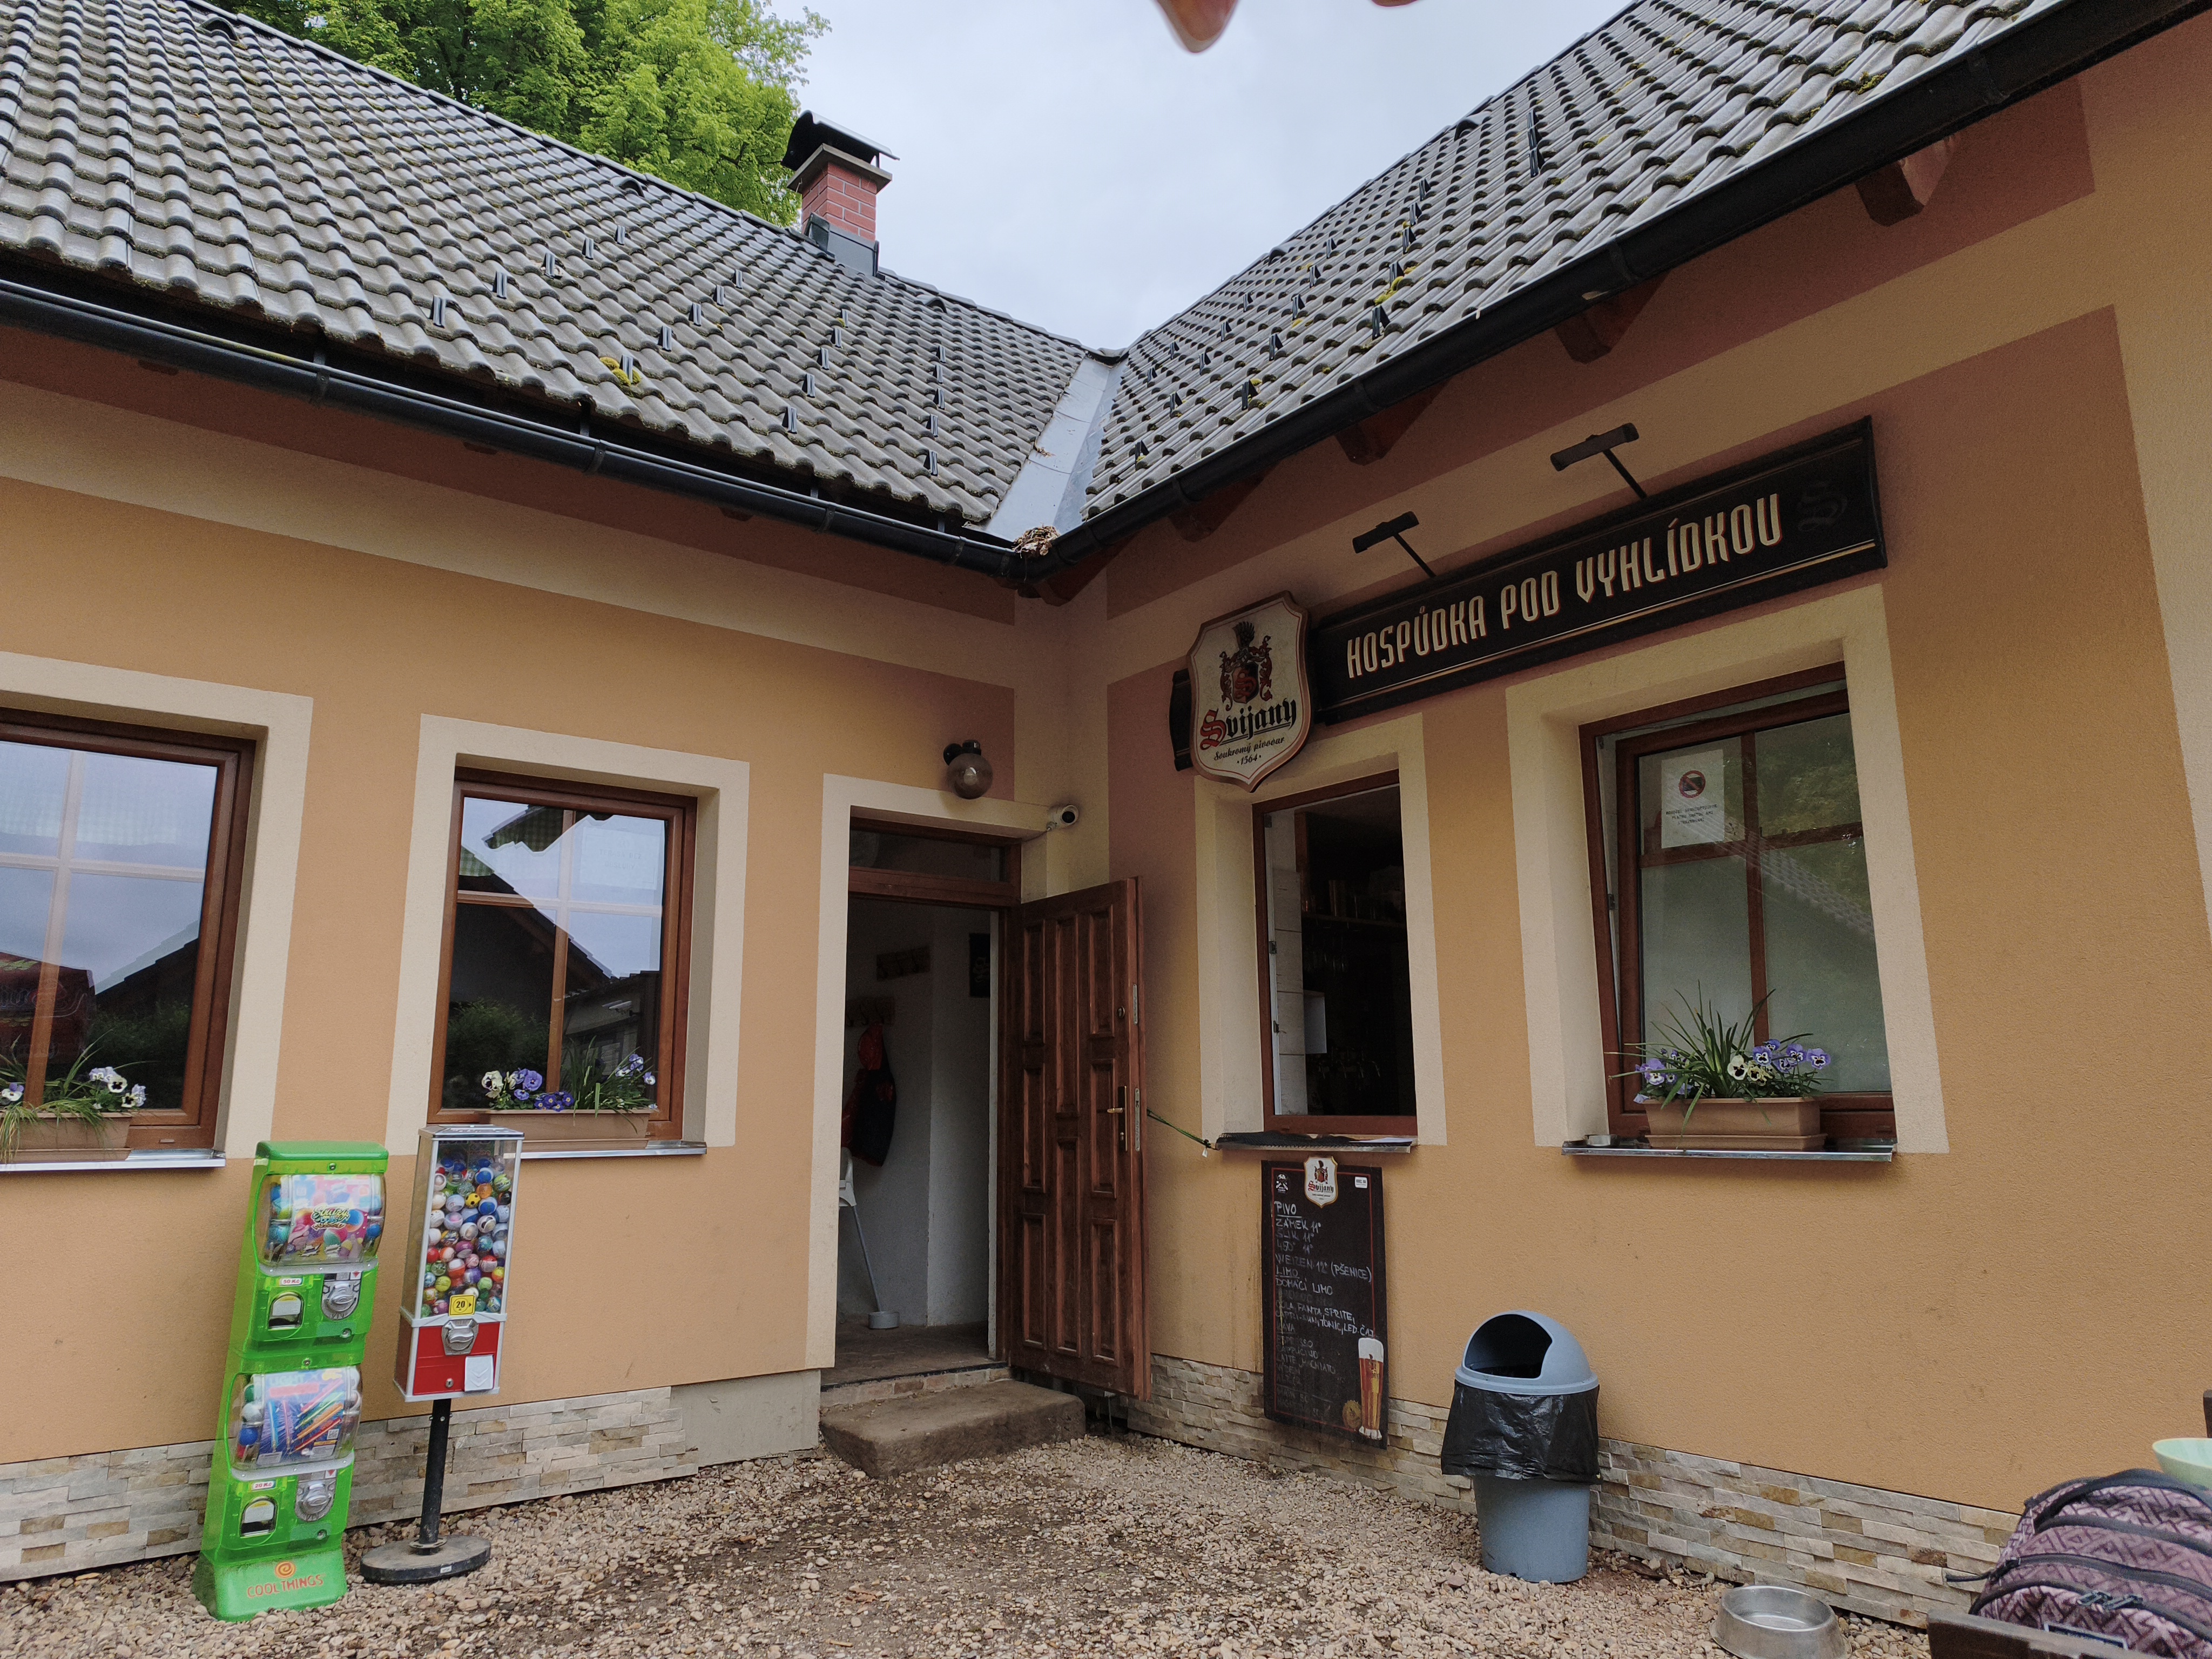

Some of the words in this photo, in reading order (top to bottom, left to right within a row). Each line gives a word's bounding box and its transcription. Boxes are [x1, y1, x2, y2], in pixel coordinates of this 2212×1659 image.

[1346, 595, 1487, 679] HOSPŮDKA
[1500, 570, 1561, 630] POD
[1575, 493, 1783, 603] VYHLÍDKOU
[1199, 698, 1297, 751] Svijany
[1213, 743, 1251, 761] Soukromý
[1253, 736, 1285, 752] pivovar
[599, 848, 625, 858] TERASA
[604, 861, 636, 870] OBSLUHY
[1308, 1180, 1334, 1193] Svijany
[1274, 1201, 1297, 1215] PIVO
[1276, 1217, 1309, 1231] ZÁMEK
[1276, 1265, 1298, 1277] LIMO
[1331, 1261, 1372, 1283] (PŠENICE)
[1312, 1283, 1333, 1296] LIMO
[455, 1300, 466, 1309] 20
[1276, 1334, 1313, 1349] ESPRSSO
[247, 1582, 280, 1599] COOL
[280, 1574, 323, 1592] THINGS
